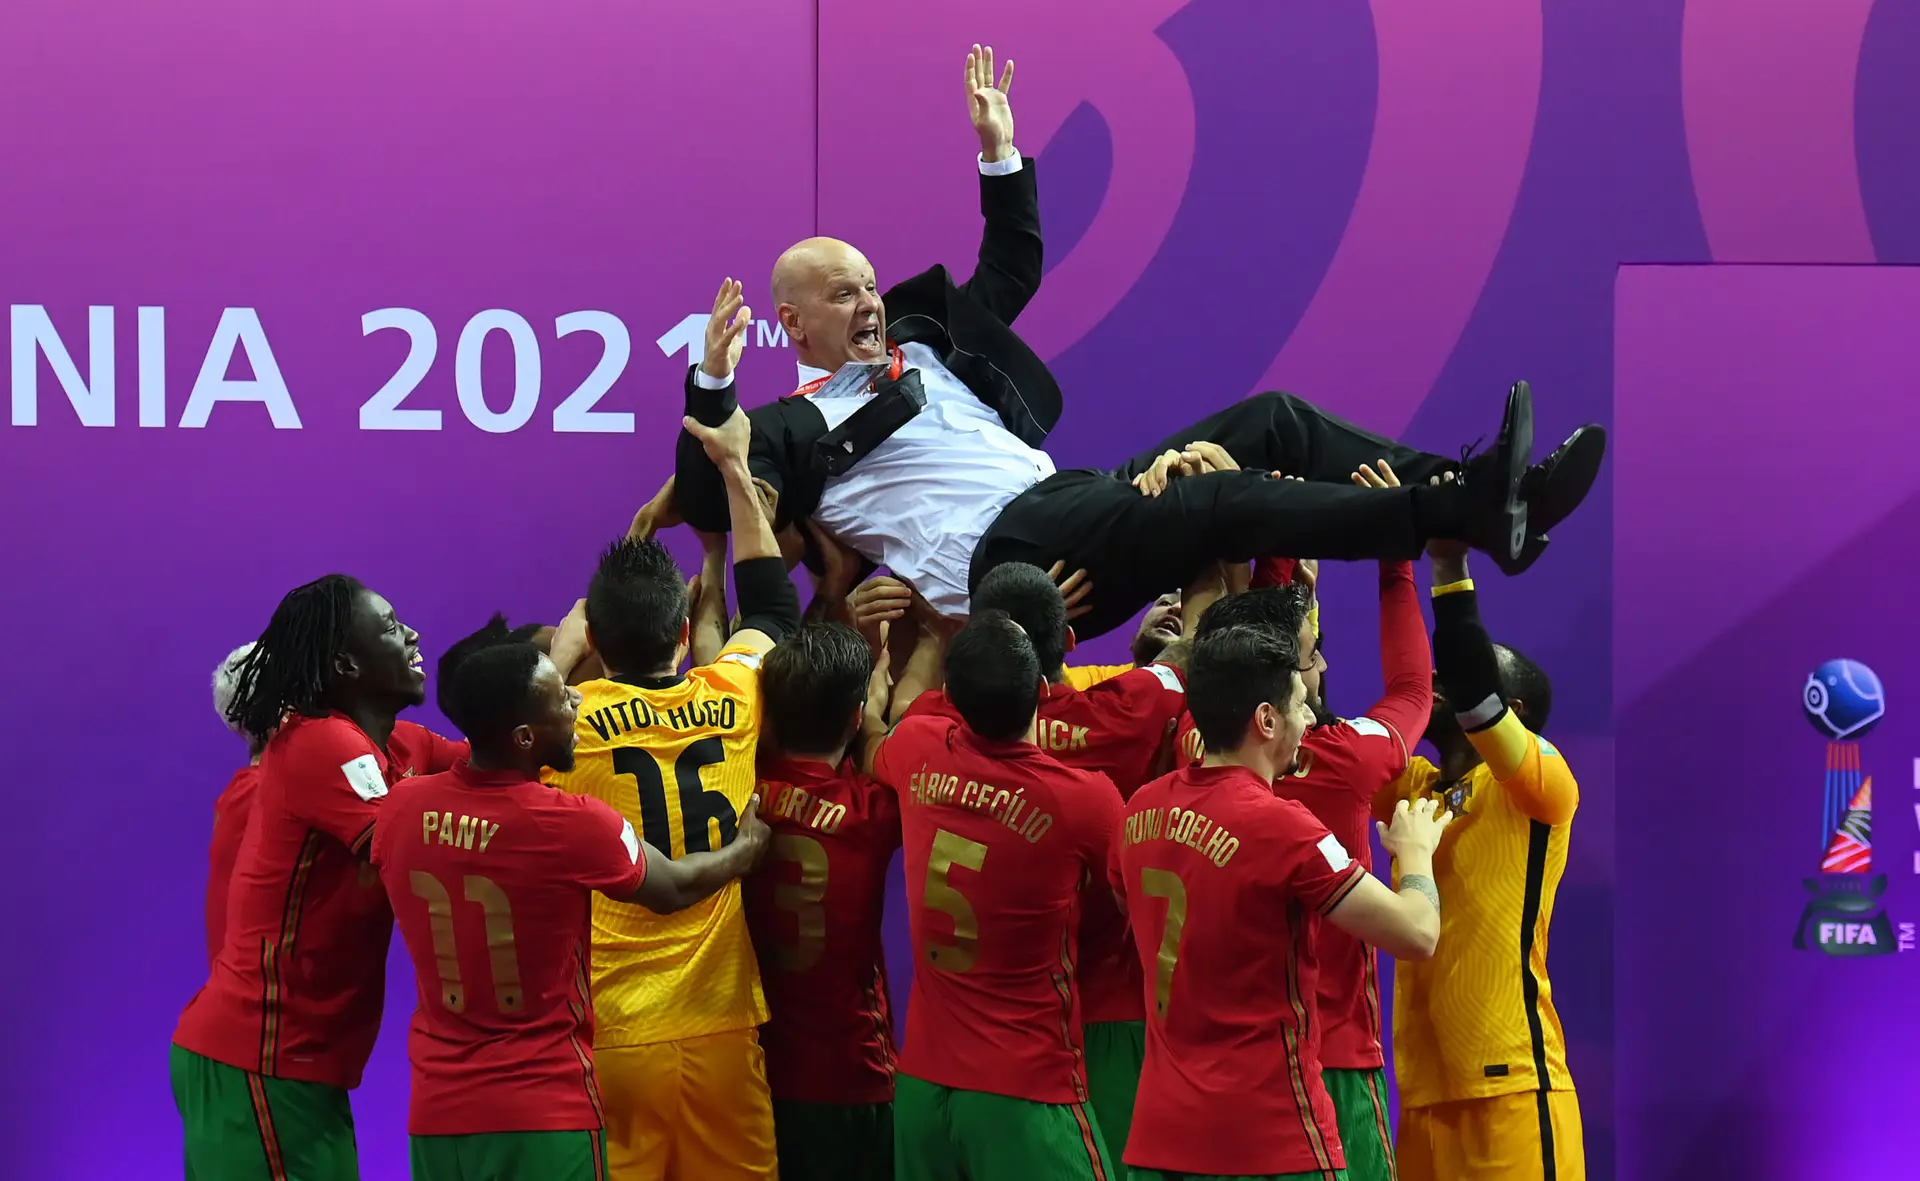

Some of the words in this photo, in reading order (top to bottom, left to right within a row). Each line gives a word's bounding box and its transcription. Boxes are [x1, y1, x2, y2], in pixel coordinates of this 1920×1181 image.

[9, 304, 303, 429] NIA
[667, 697, 736, 730] HUGO
[422, 811, 500, 853] PANY
[611, 736, 739, 860] 16
[773, 786, 847, 835] BRITO
[909, 762, 959, 806] FÁBIO
[961, 780, 1053, 844] CECÍLIO
[1165, 806, 1241, 868] COELHO
[768, 834, 830, 972] 3
[924, 828, 988, 974] 5
[1818, 922, 1878, 945] FIFA
[1898, 921, 1916, 953] TM
[409, 870, 525, 1015] 11
[1141, 867, 1187, 1020] 7
